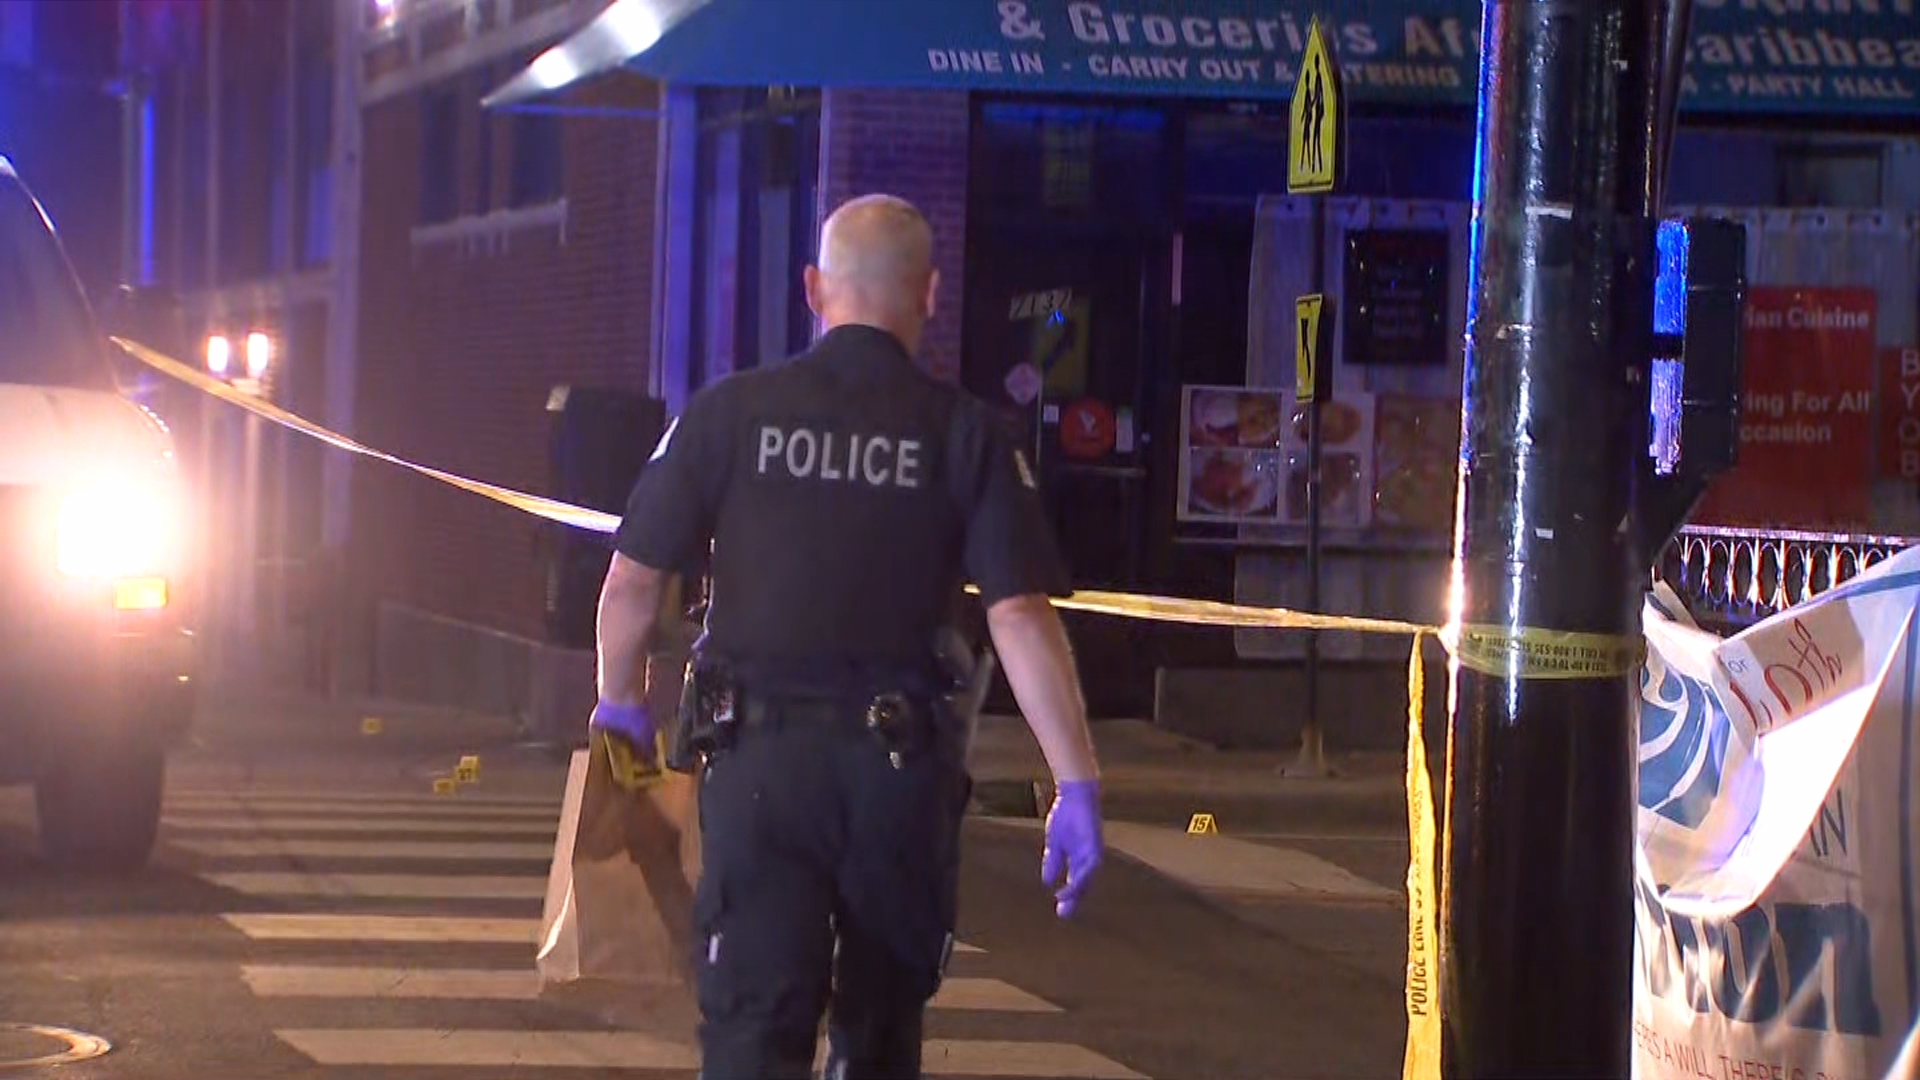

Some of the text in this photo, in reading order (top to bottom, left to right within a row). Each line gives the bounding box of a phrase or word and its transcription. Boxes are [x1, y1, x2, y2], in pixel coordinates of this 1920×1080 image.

[996, 0, 1920, 67] & Groceris Af aribbea
[927, 48, 1003, 73] DINE
[1009, 52, 1045, 74] IN
[1087, 54, 1189, 80] CARRY
[1200, 58, 1261, 82] OUT
[1339, 62, 1460, 87] TERING
[1727, 73, 1823, 97] PARTY
[1833, 76, 1914, 98] HALL
[1743, 306, 1869, 328] ian Cuisine
[1745, 390, 1870, 417] ing For All
[1739, 420, 1832, 443] ccasion
[757, 425, 922, 488] POLICE
[1192, 817, 1207, 831] 15
